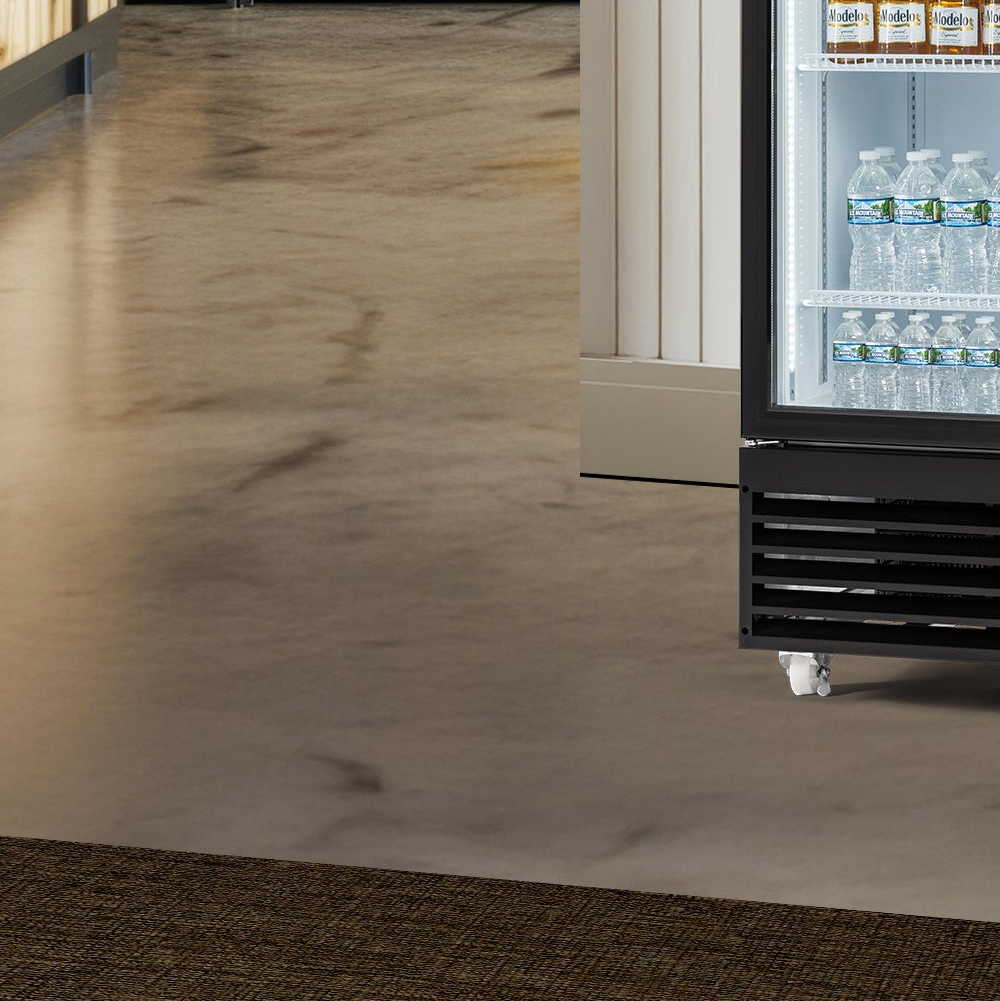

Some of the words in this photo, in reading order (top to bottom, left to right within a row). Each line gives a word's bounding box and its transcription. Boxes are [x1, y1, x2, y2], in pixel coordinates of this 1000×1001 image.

[829, 9, 864, 23] Modelo
[881, 9, 915, 23] Modelo
[933, 11, 969, 26] Modelo
